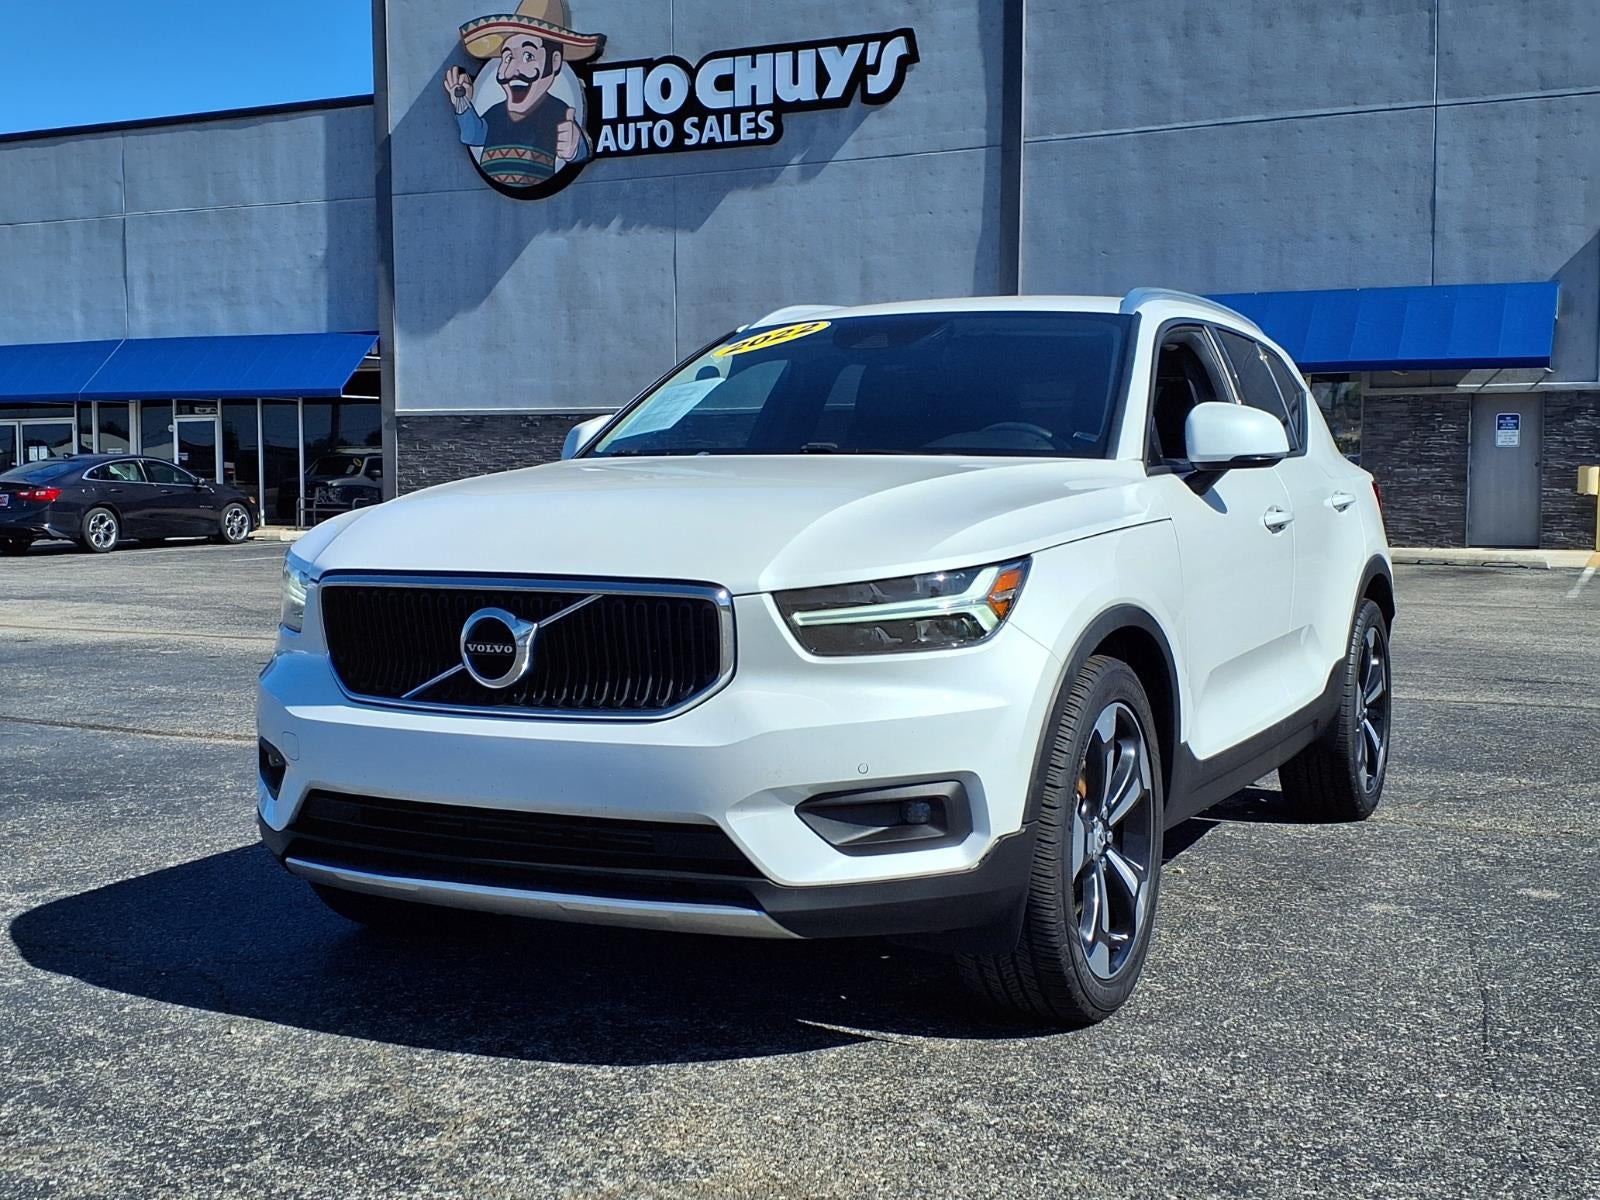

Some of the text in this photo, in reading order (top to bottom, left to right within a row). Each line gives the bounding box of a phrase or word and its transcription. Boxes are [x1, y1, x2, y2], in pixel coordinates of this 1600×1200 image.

[593, 36, 908, 119] TIO CHUY'S
[596, 110, 775, 152] AUTO SALES
[720, 322, 820, 355] 2022
[466, 643, 513, 654] VOLVO
